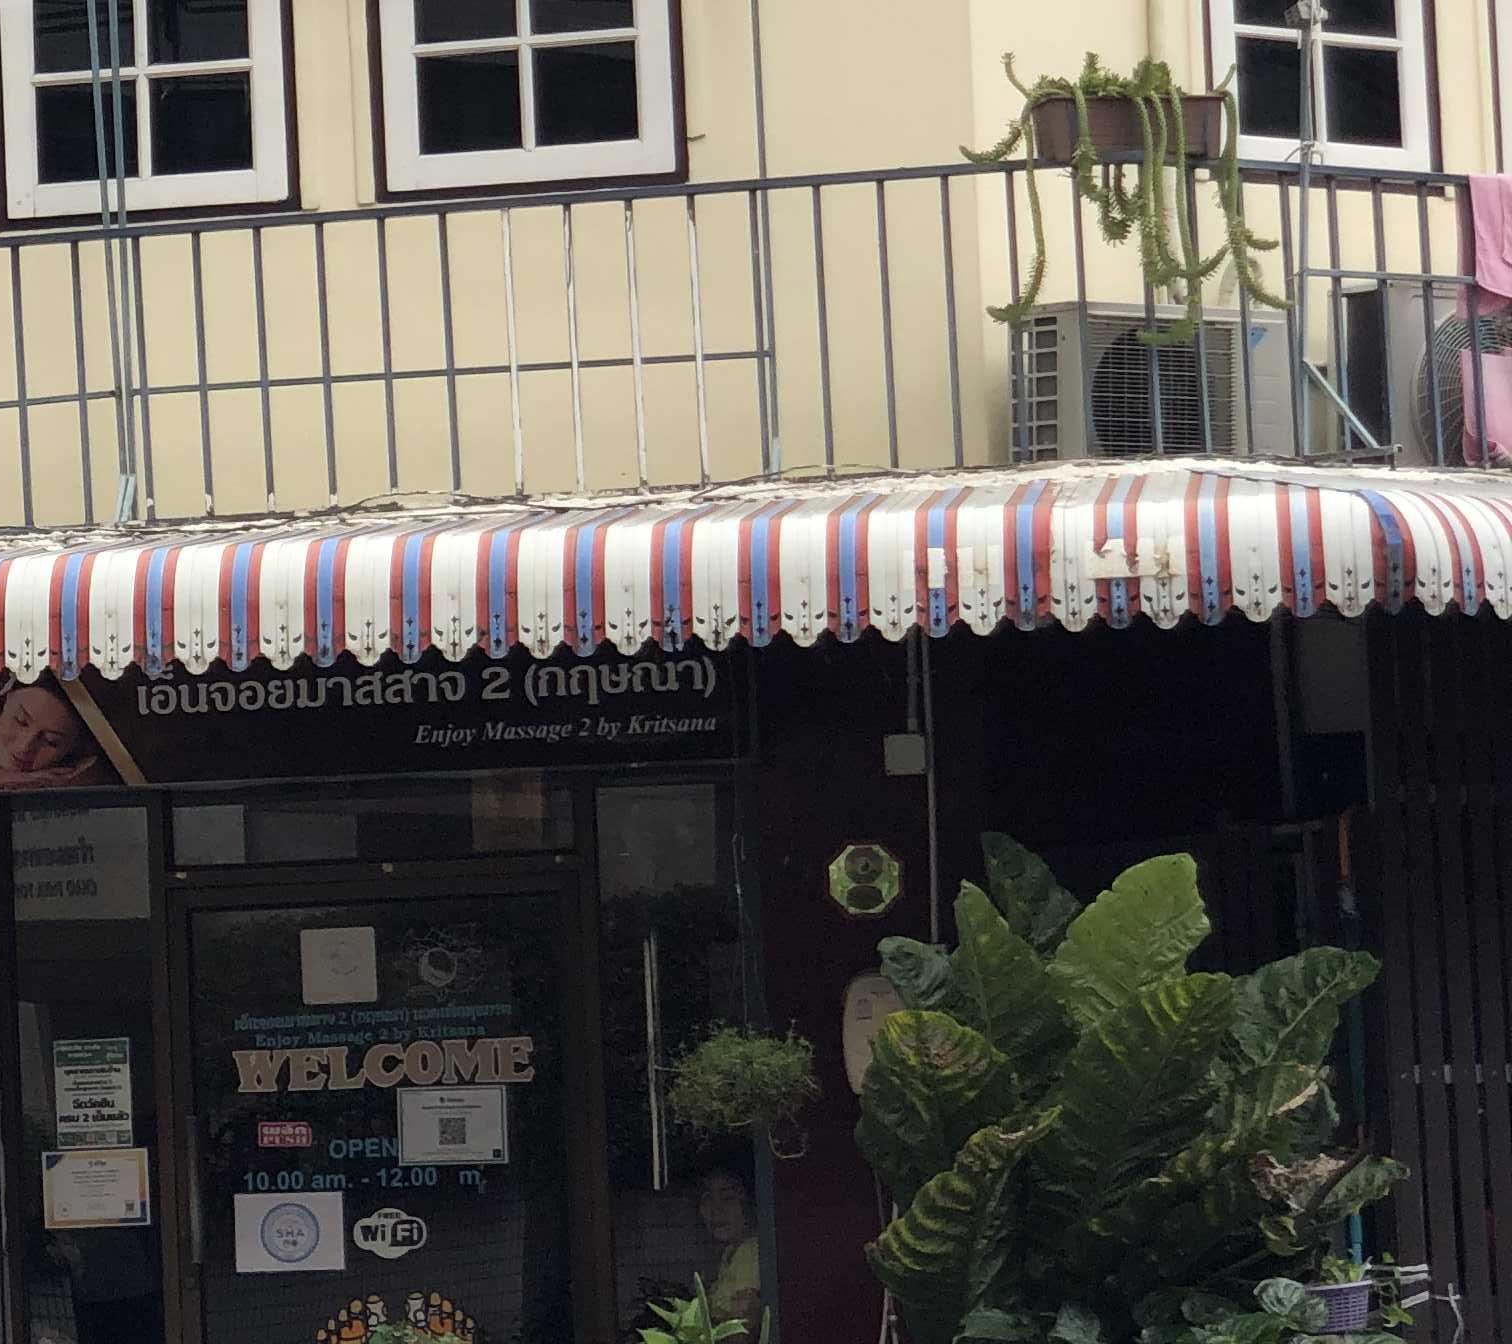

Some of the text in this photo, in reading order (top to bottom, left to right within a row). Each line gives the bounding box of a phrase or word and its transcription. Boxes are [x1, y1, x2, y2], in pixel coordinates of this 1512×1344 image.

[136, 656, 717, 716] เอ็นจอยมาสสาจ 2 (กฤษณา)
[414, 713, 717, 747] Enjoy Massage 2 by Kritsana
[255, 1032, 300, 1049] Enjoy
[232, 1035, 536, 1093] WELCOME
[329, 1137, 398, 1160] OPEN
[243, 1170, 305, 1192] 10.00
[311, 1172, 355, 1189] am.
[377, 1166, 438, 1188] 12.00
